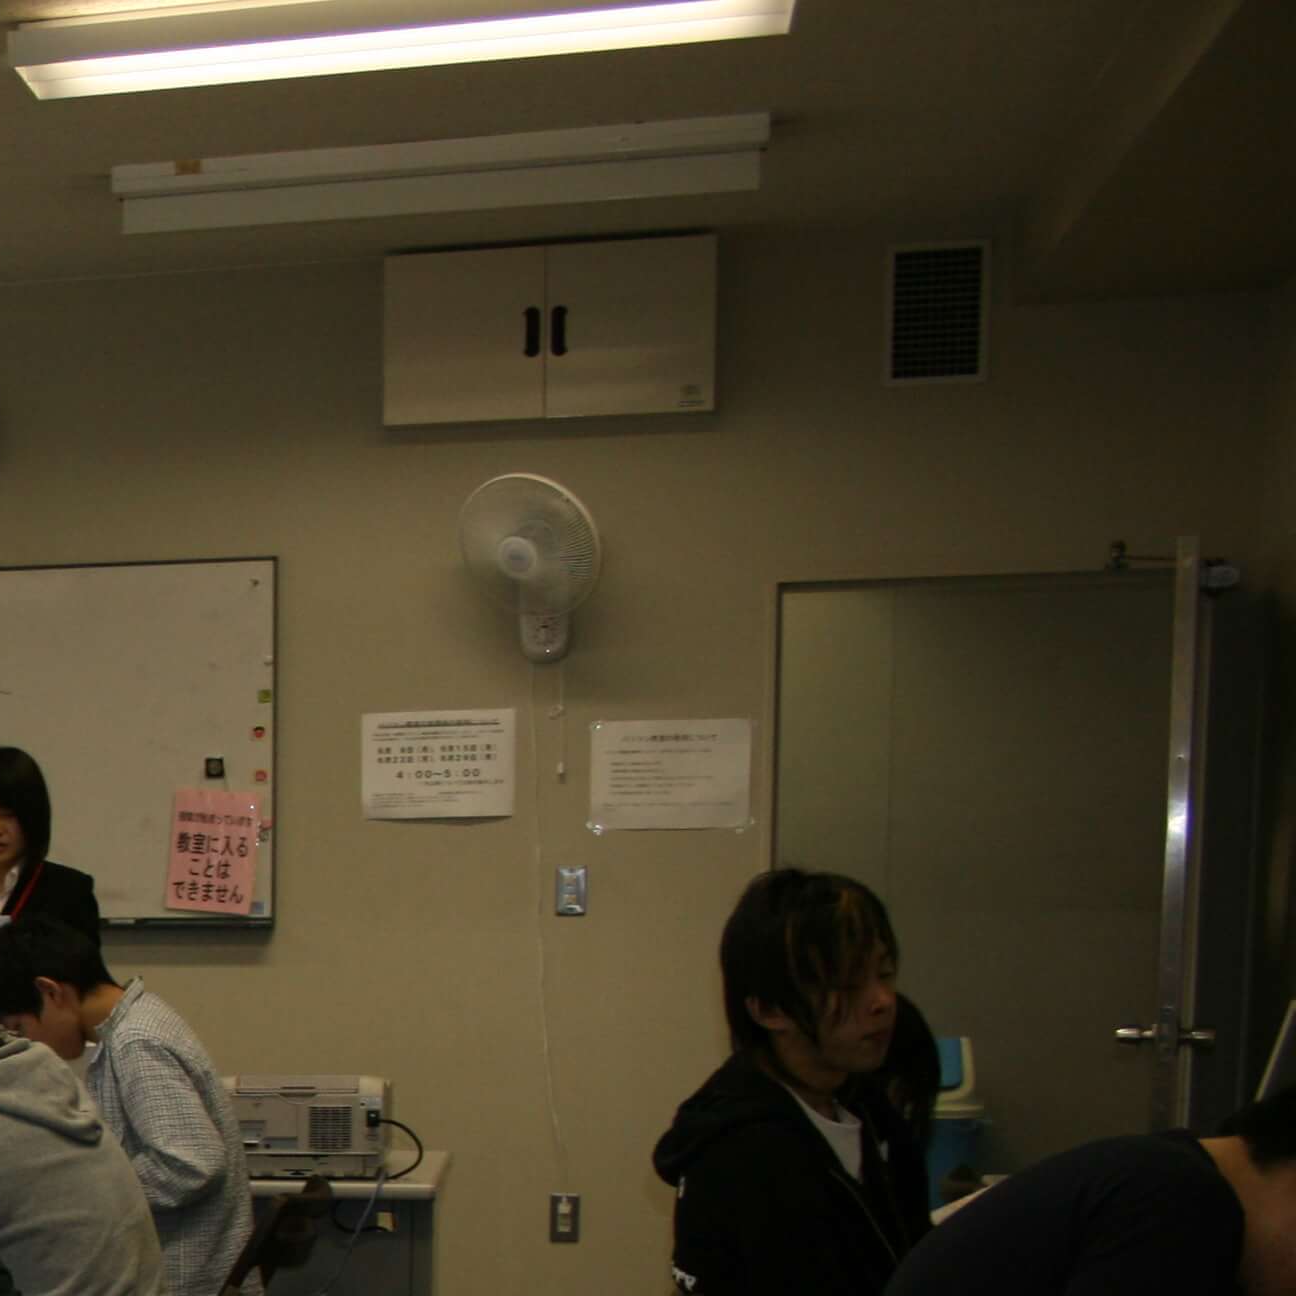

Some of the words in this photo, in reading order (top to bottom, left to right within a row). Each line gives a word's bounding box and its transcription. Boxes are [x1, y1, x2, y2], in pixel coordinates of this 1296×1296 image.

[176, 831, 249, 858] 教室に入る
[188, 858, 232, 880] ことは
[171, 879, 244, 904] できません
